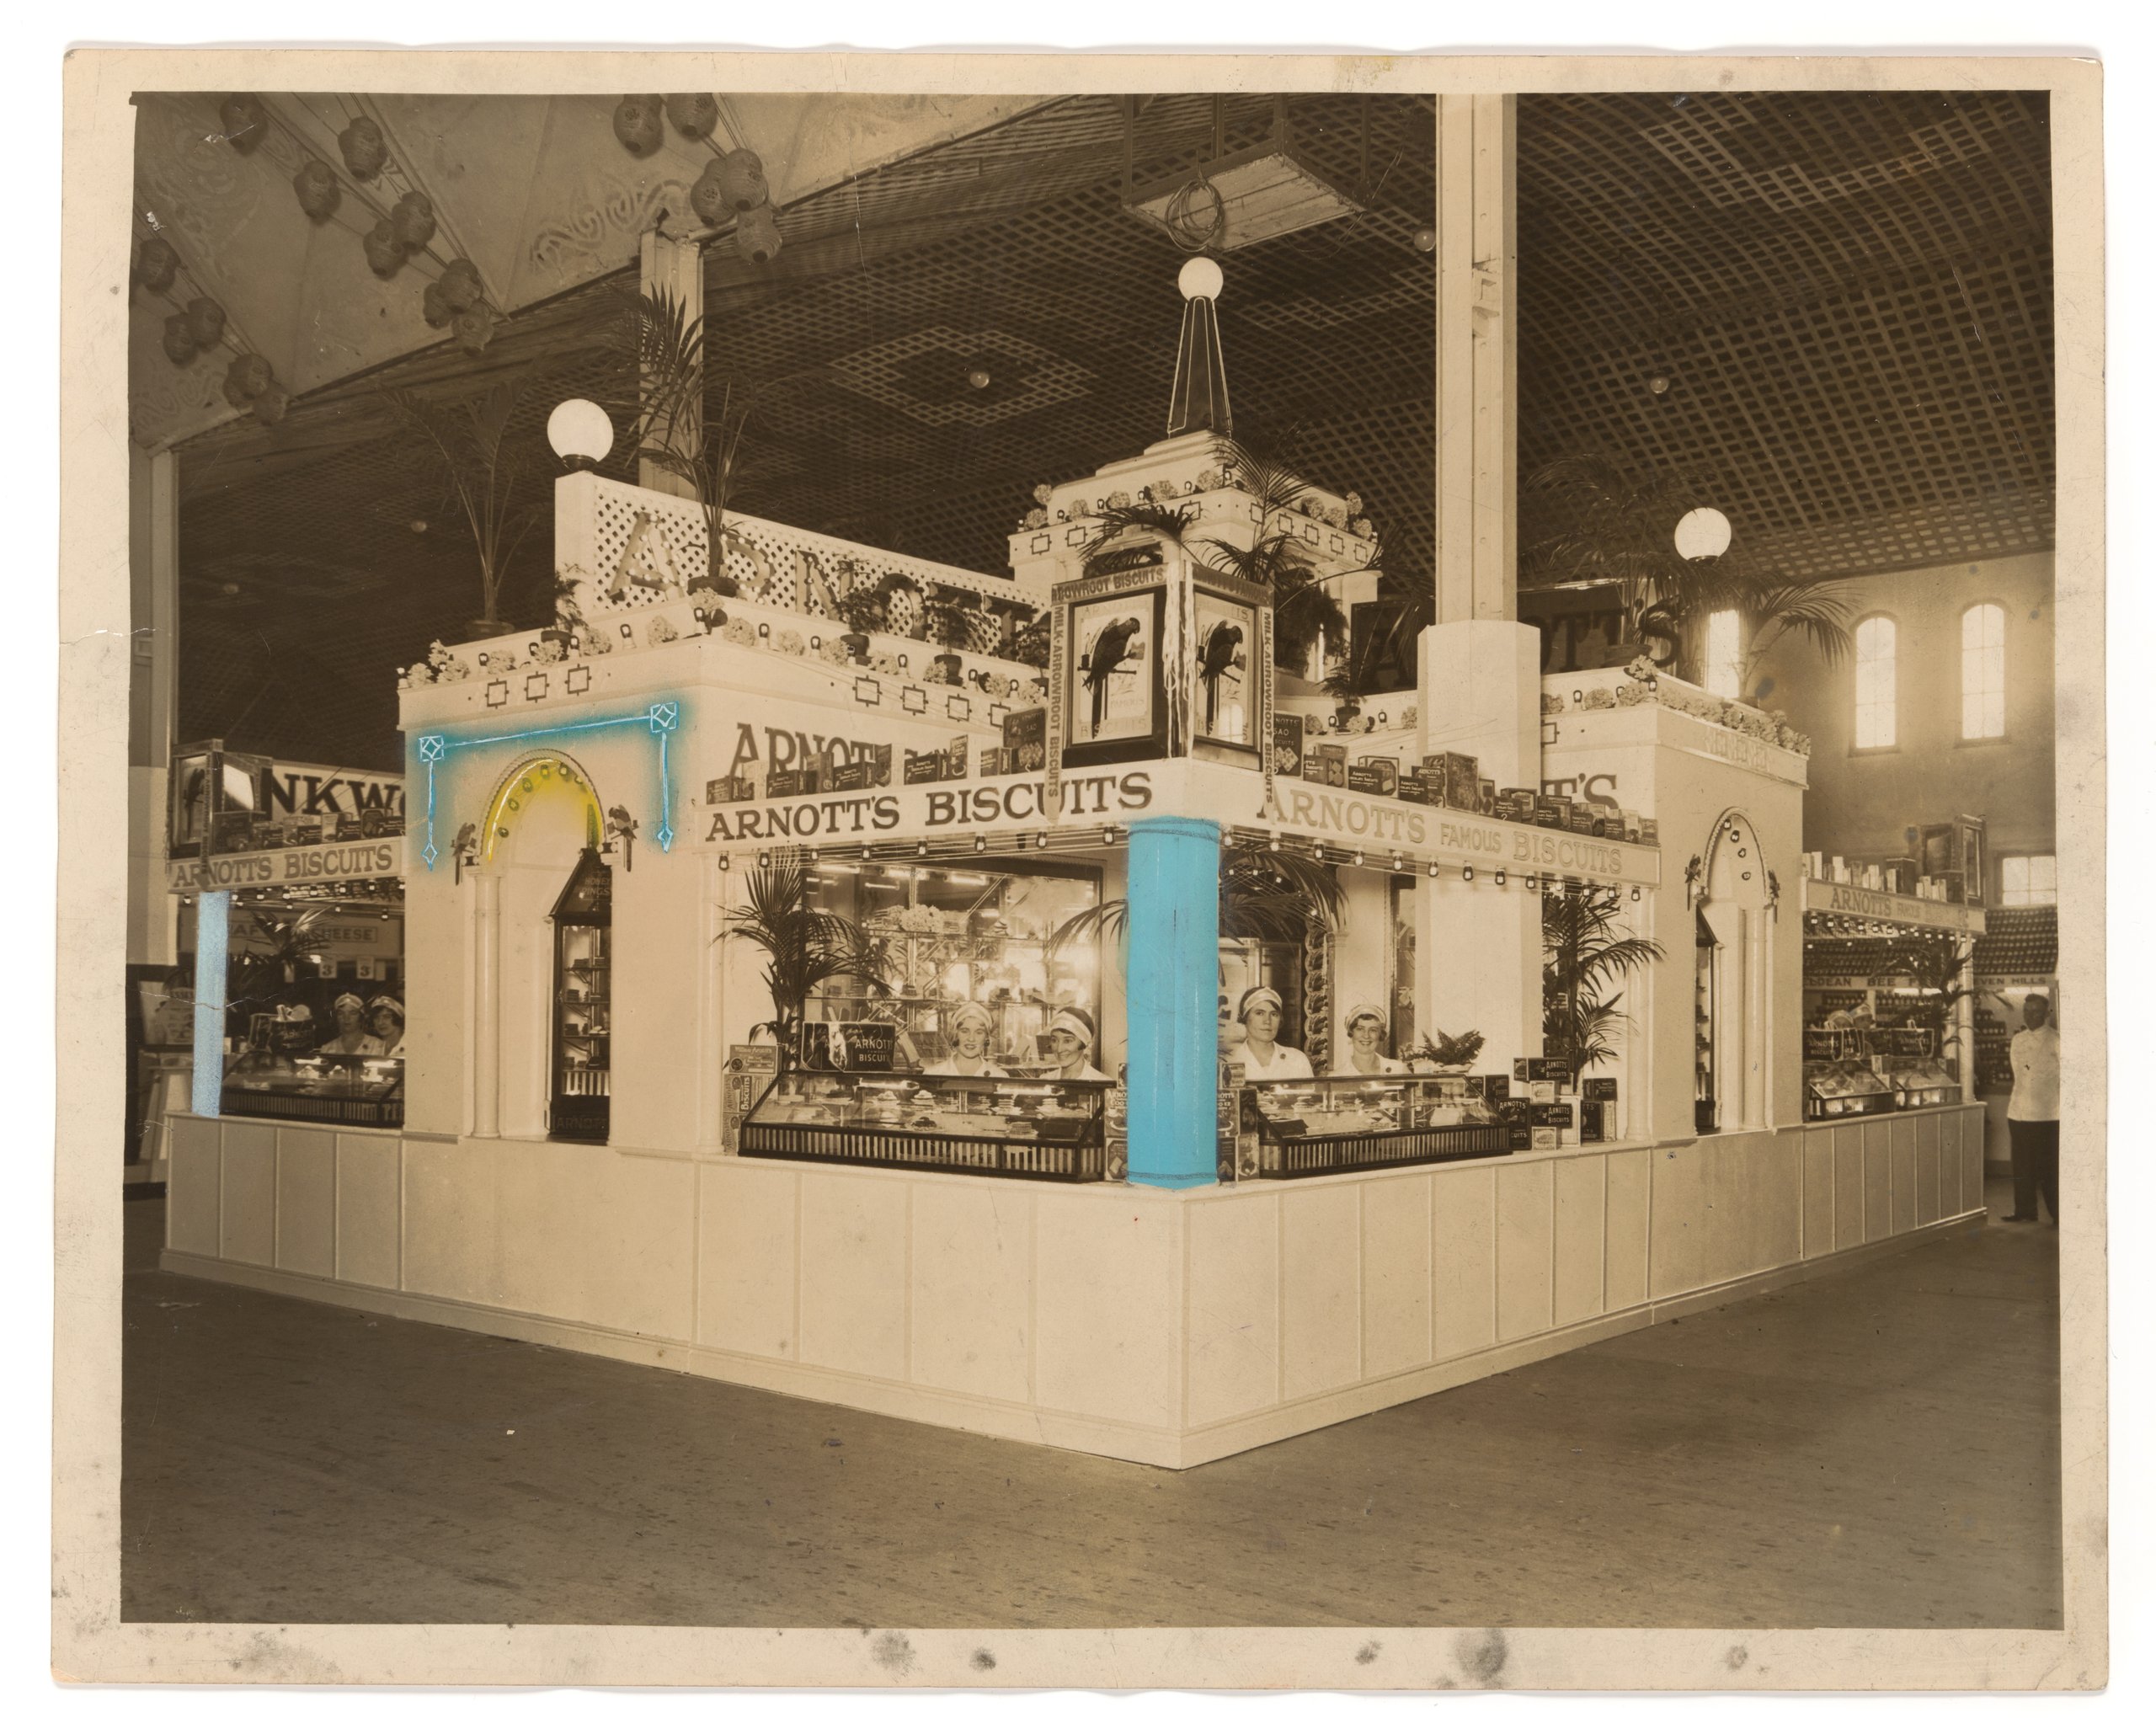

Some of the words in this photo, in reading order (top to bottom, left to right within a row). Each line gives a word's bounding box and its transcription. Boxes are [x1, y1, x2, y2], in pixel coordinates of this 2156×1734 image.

[1113, 567, 1164, 590] BISCUITS
[1048, 735, 1060, 798] BISCUITS
[706, 796, 899, 841] ARNOTT'S
[926, 766, 1152, 826] BISCUITS
[1257, 786, 1427, 843] ARNOTT'S
[1441, 822, 1502, 854] FAMOUS
[1513, 830, 1622, 874] BISCUITS
[284, 845, 392, 878] BISCUITS
[1867, 978, 1896, 986] BEE
